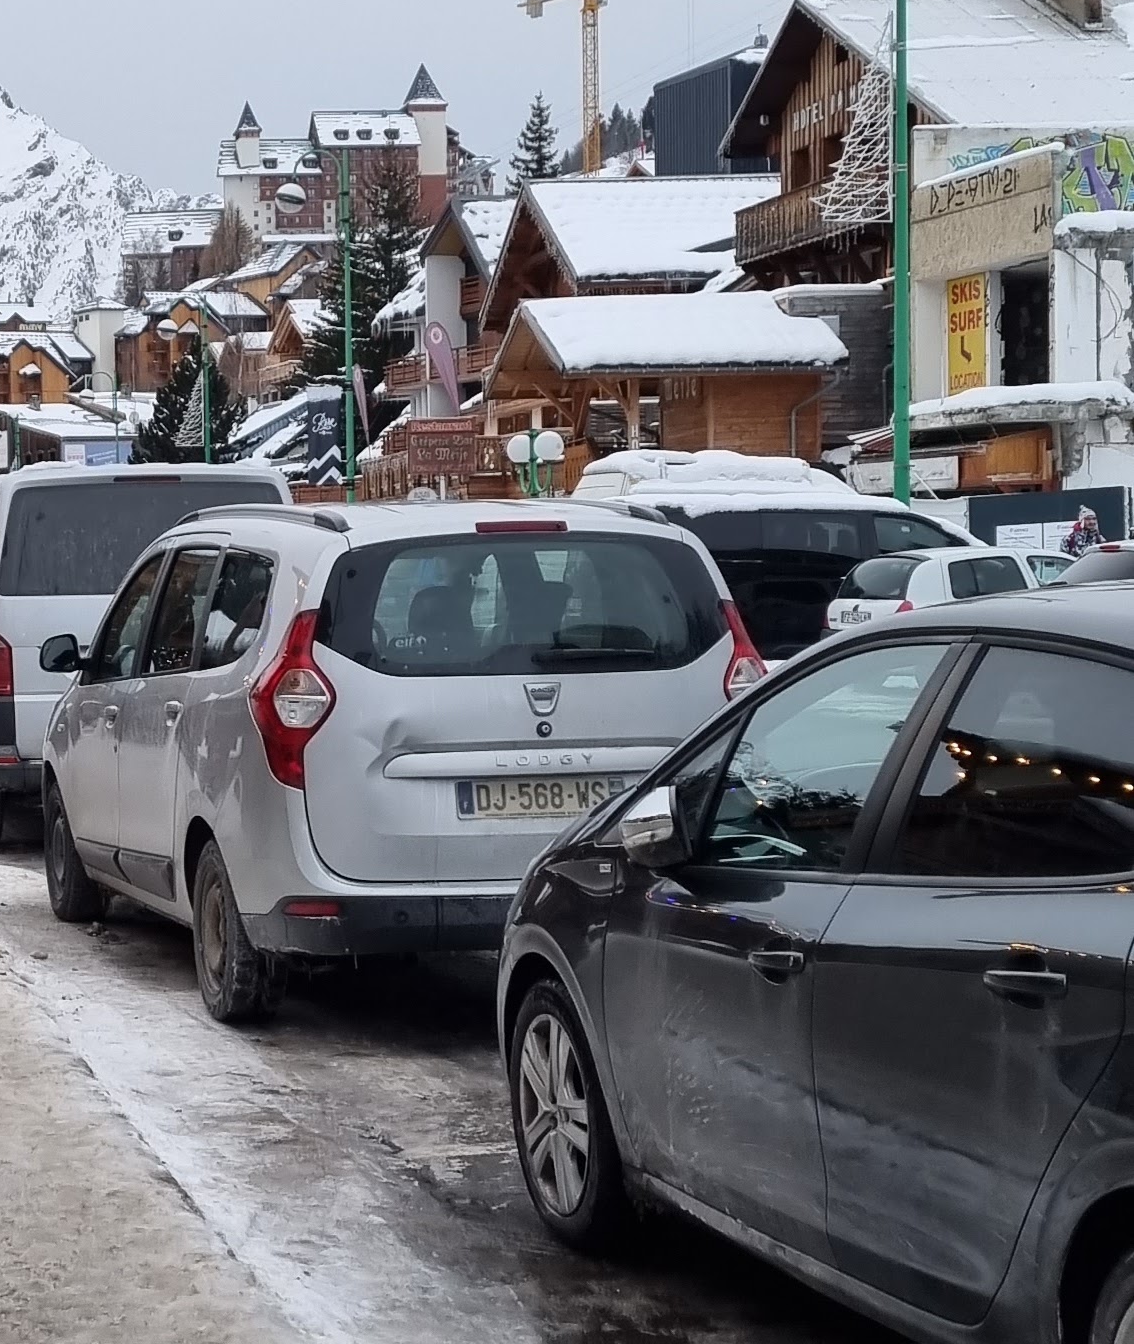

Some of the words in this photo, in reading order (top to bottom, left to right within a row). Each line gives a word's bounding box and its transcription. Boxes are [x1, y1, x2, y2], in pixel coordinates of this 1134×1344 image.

[793, 100, 824, 133] HOTEL
[951, 279, 981, 305] SKIS
[950, 307, 983, 334] SURF
[950, 371, 984, 390] LOCATION
[496, 753, 594, 767] LODGY
[476, 780, 605, 812] DJ-568-WS
